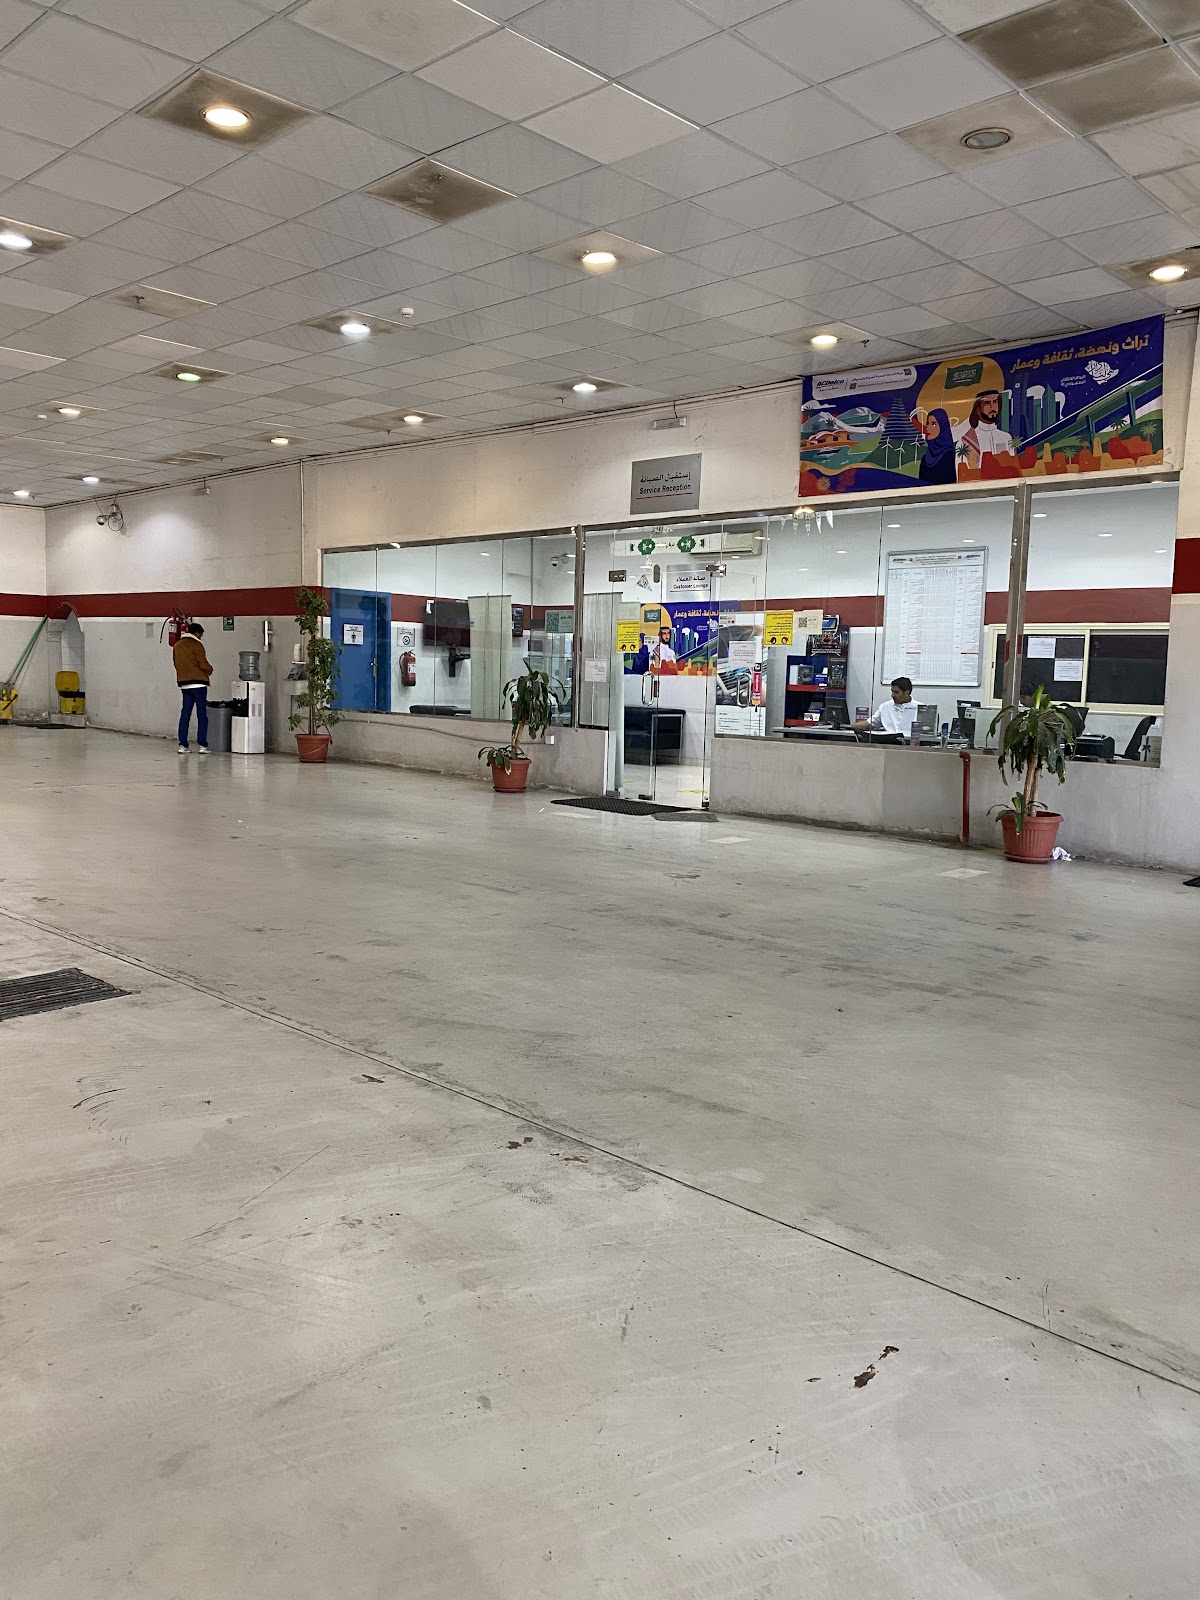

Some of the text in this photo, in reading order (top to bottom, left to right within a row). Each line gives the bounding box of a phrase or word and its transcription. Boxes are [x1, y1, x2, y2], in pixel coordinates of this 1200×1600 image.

[1122, 334, 1150, 351] تراث
[1042, 347, 1075, 365] ثقافة
[1009, 358, 1041, 374] وعمار
[816, 379, 845, 387] ACDelco
[640, 471, 691, 484] إستقبال الصيانة
[639, 484, 692, 495] Service Reception
